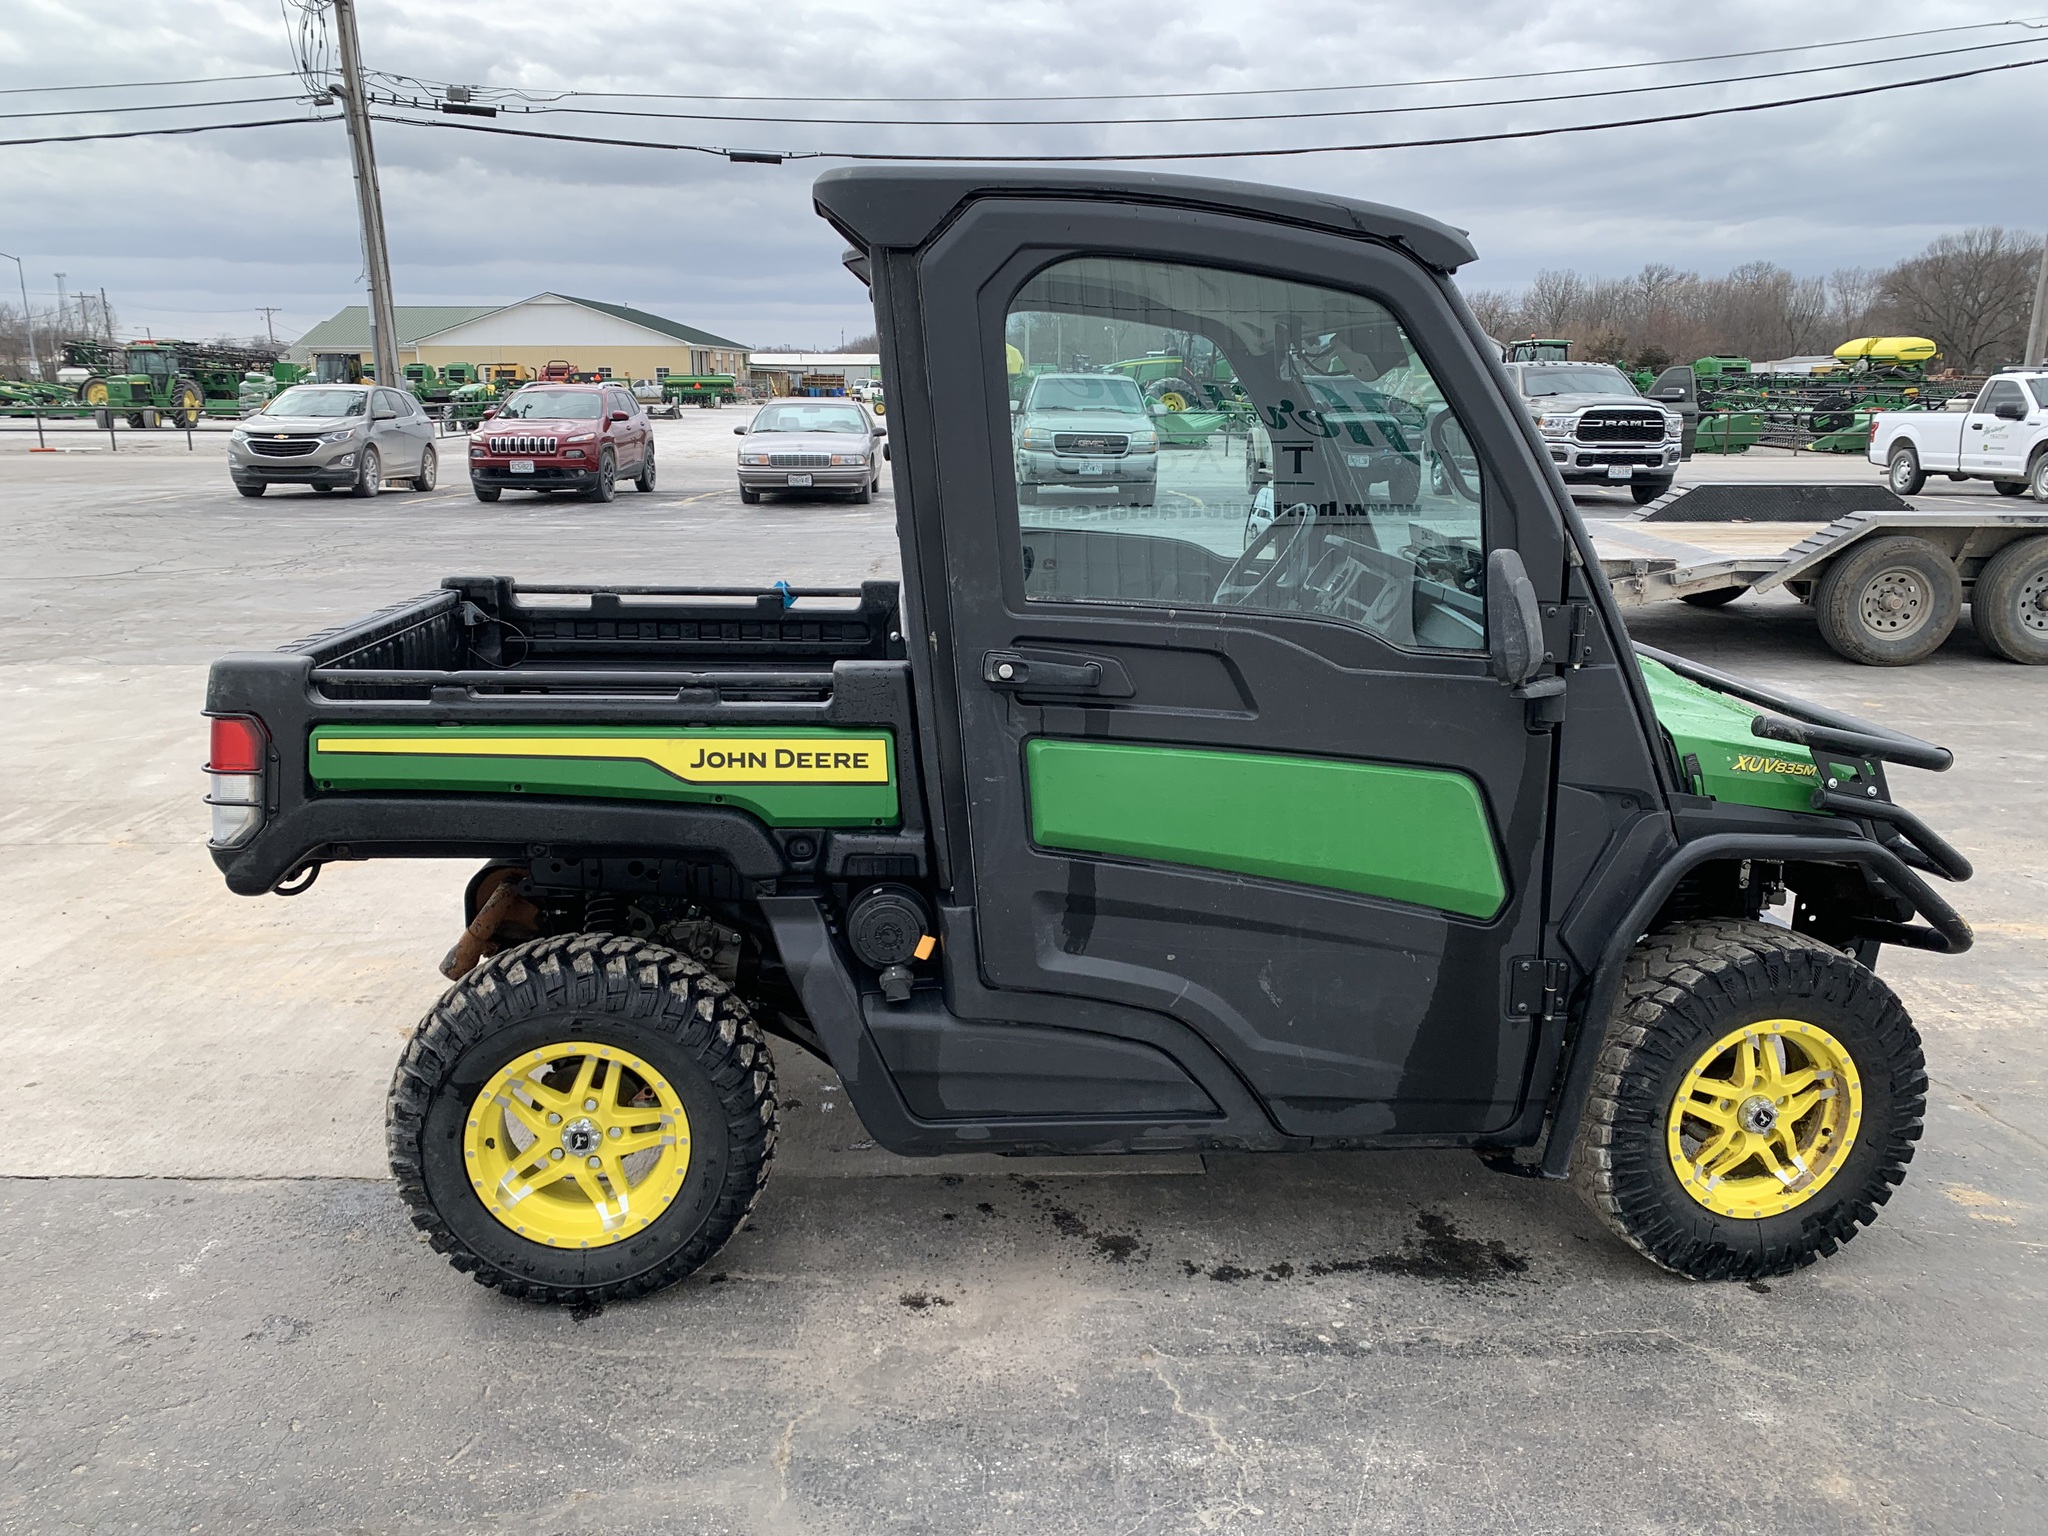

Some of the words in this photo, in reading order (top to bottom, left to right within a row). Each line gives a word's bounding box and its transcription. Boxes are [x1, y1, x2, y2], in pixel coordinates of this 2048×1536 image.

[1078, 439, 1104, 448] GMC
[690, 748, 767, 769] JOHN
[775, 748, 869, 769] DEERE
[1730, 754, 1818, 777] XUV835M
